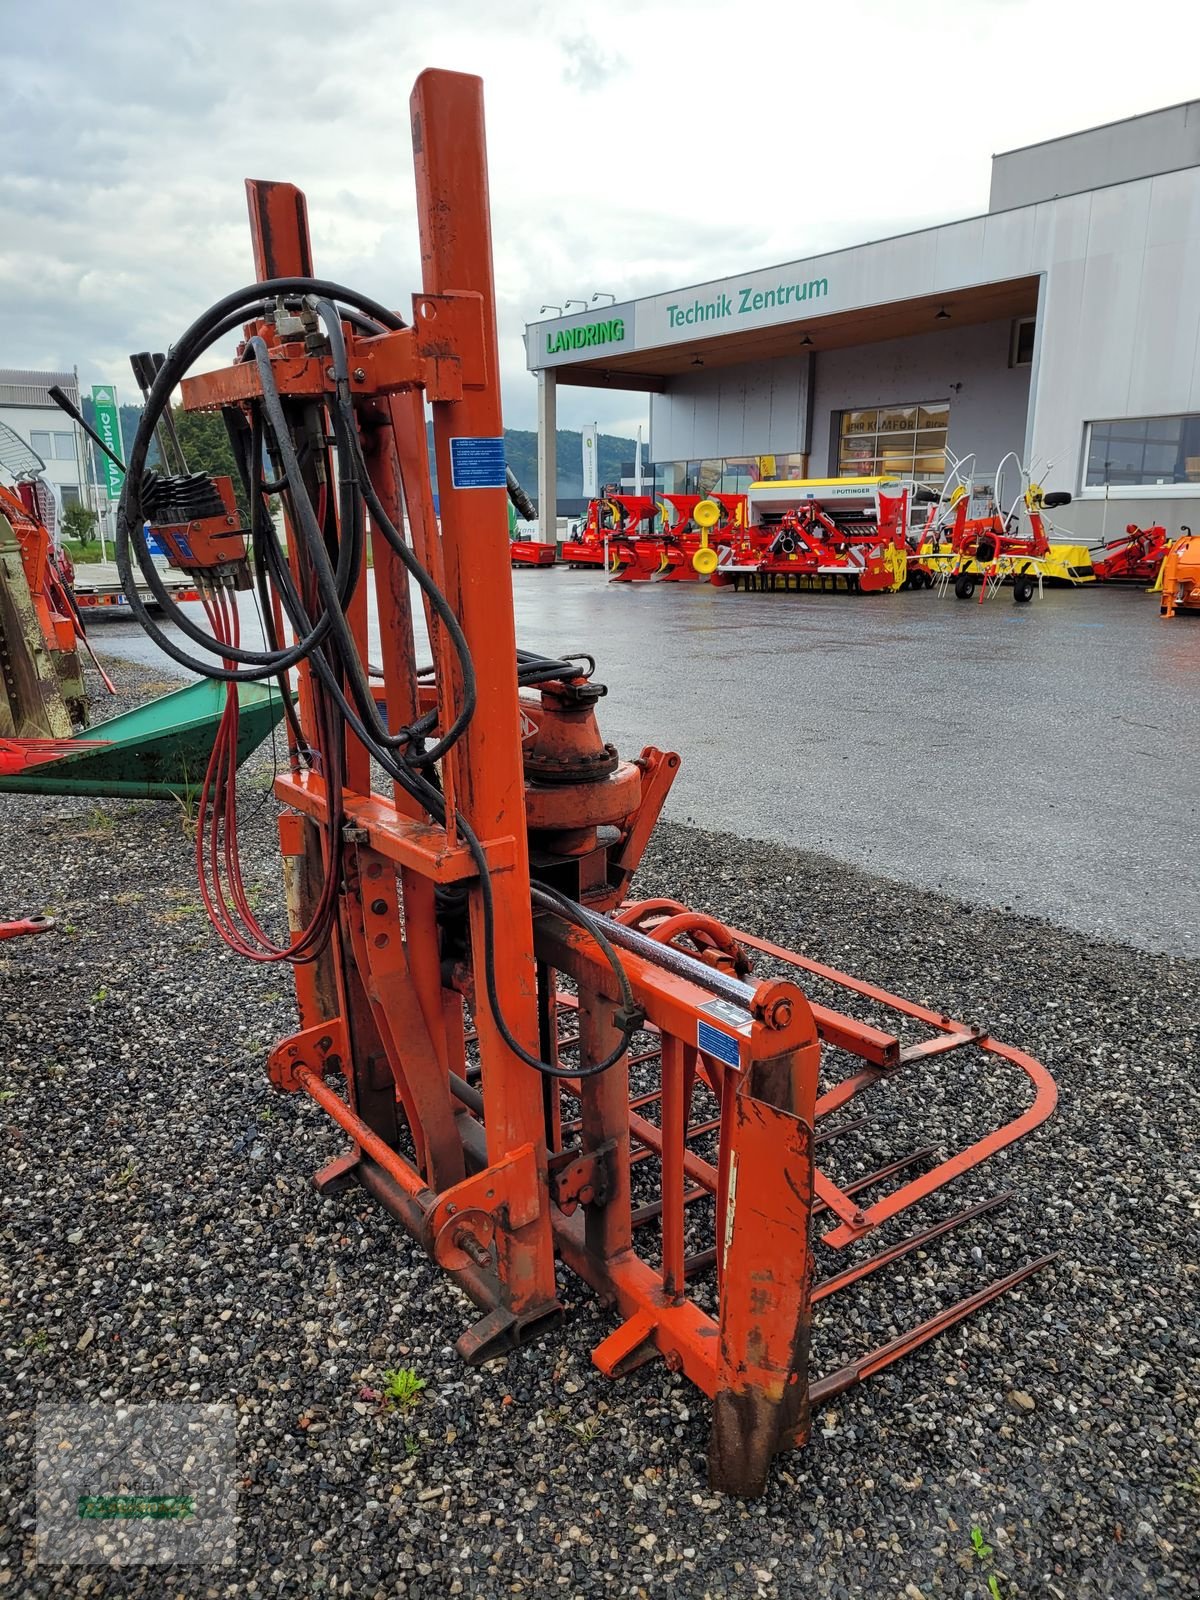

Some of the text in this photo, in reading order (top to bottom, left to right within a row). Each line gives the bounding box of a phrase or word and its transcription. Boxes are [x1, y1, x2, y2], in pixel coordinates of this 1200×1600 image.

[666, 278, 828, 328] Technik Zentrum
[546, 318, 625, 354] LANDRING
